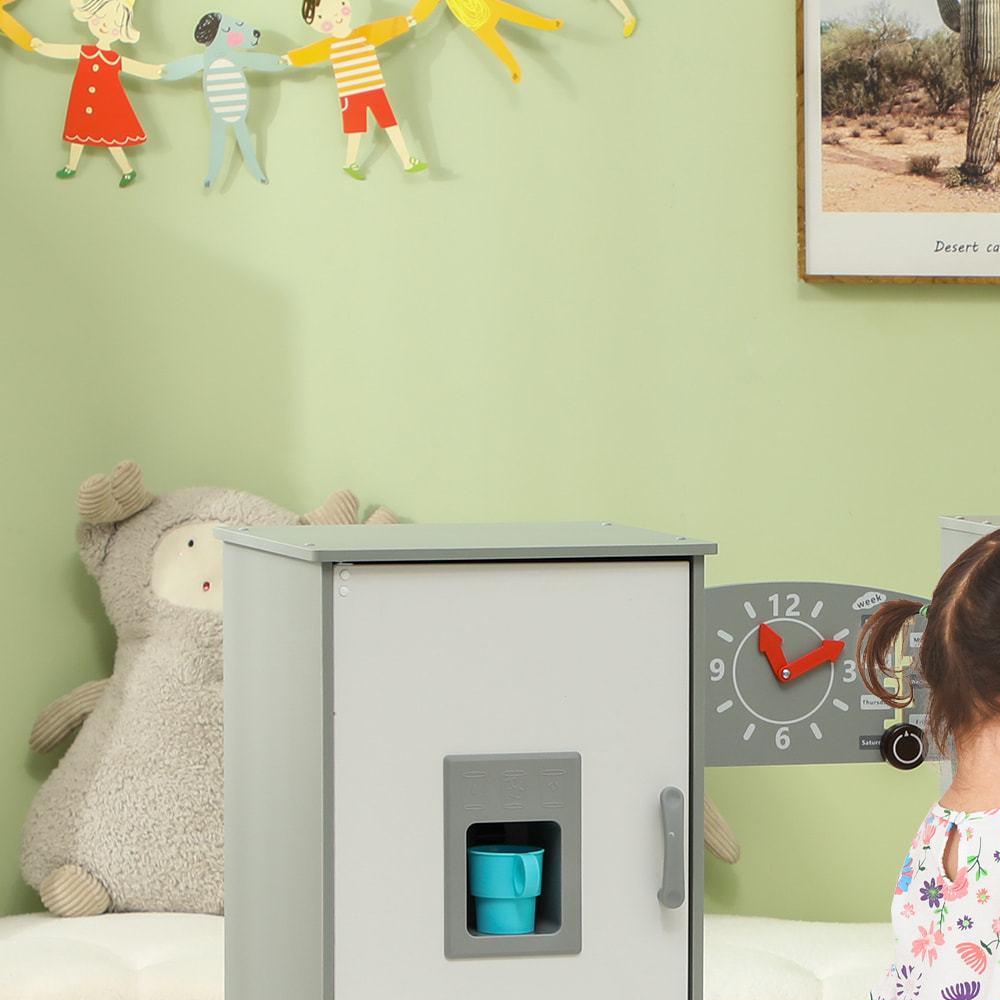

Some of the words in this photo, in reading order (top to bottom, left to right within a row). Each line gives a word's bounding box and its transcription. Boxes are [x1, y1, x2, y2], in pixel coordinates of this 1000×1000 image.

[934, 240, 979, 253] Desert
[768, 593, 801, 617] 12
[856, 593, 882, 609] week
[709, 658, 725, 681] 9
[842, 659, 857, 683] 3
[775, 727, 791, 750] 6
